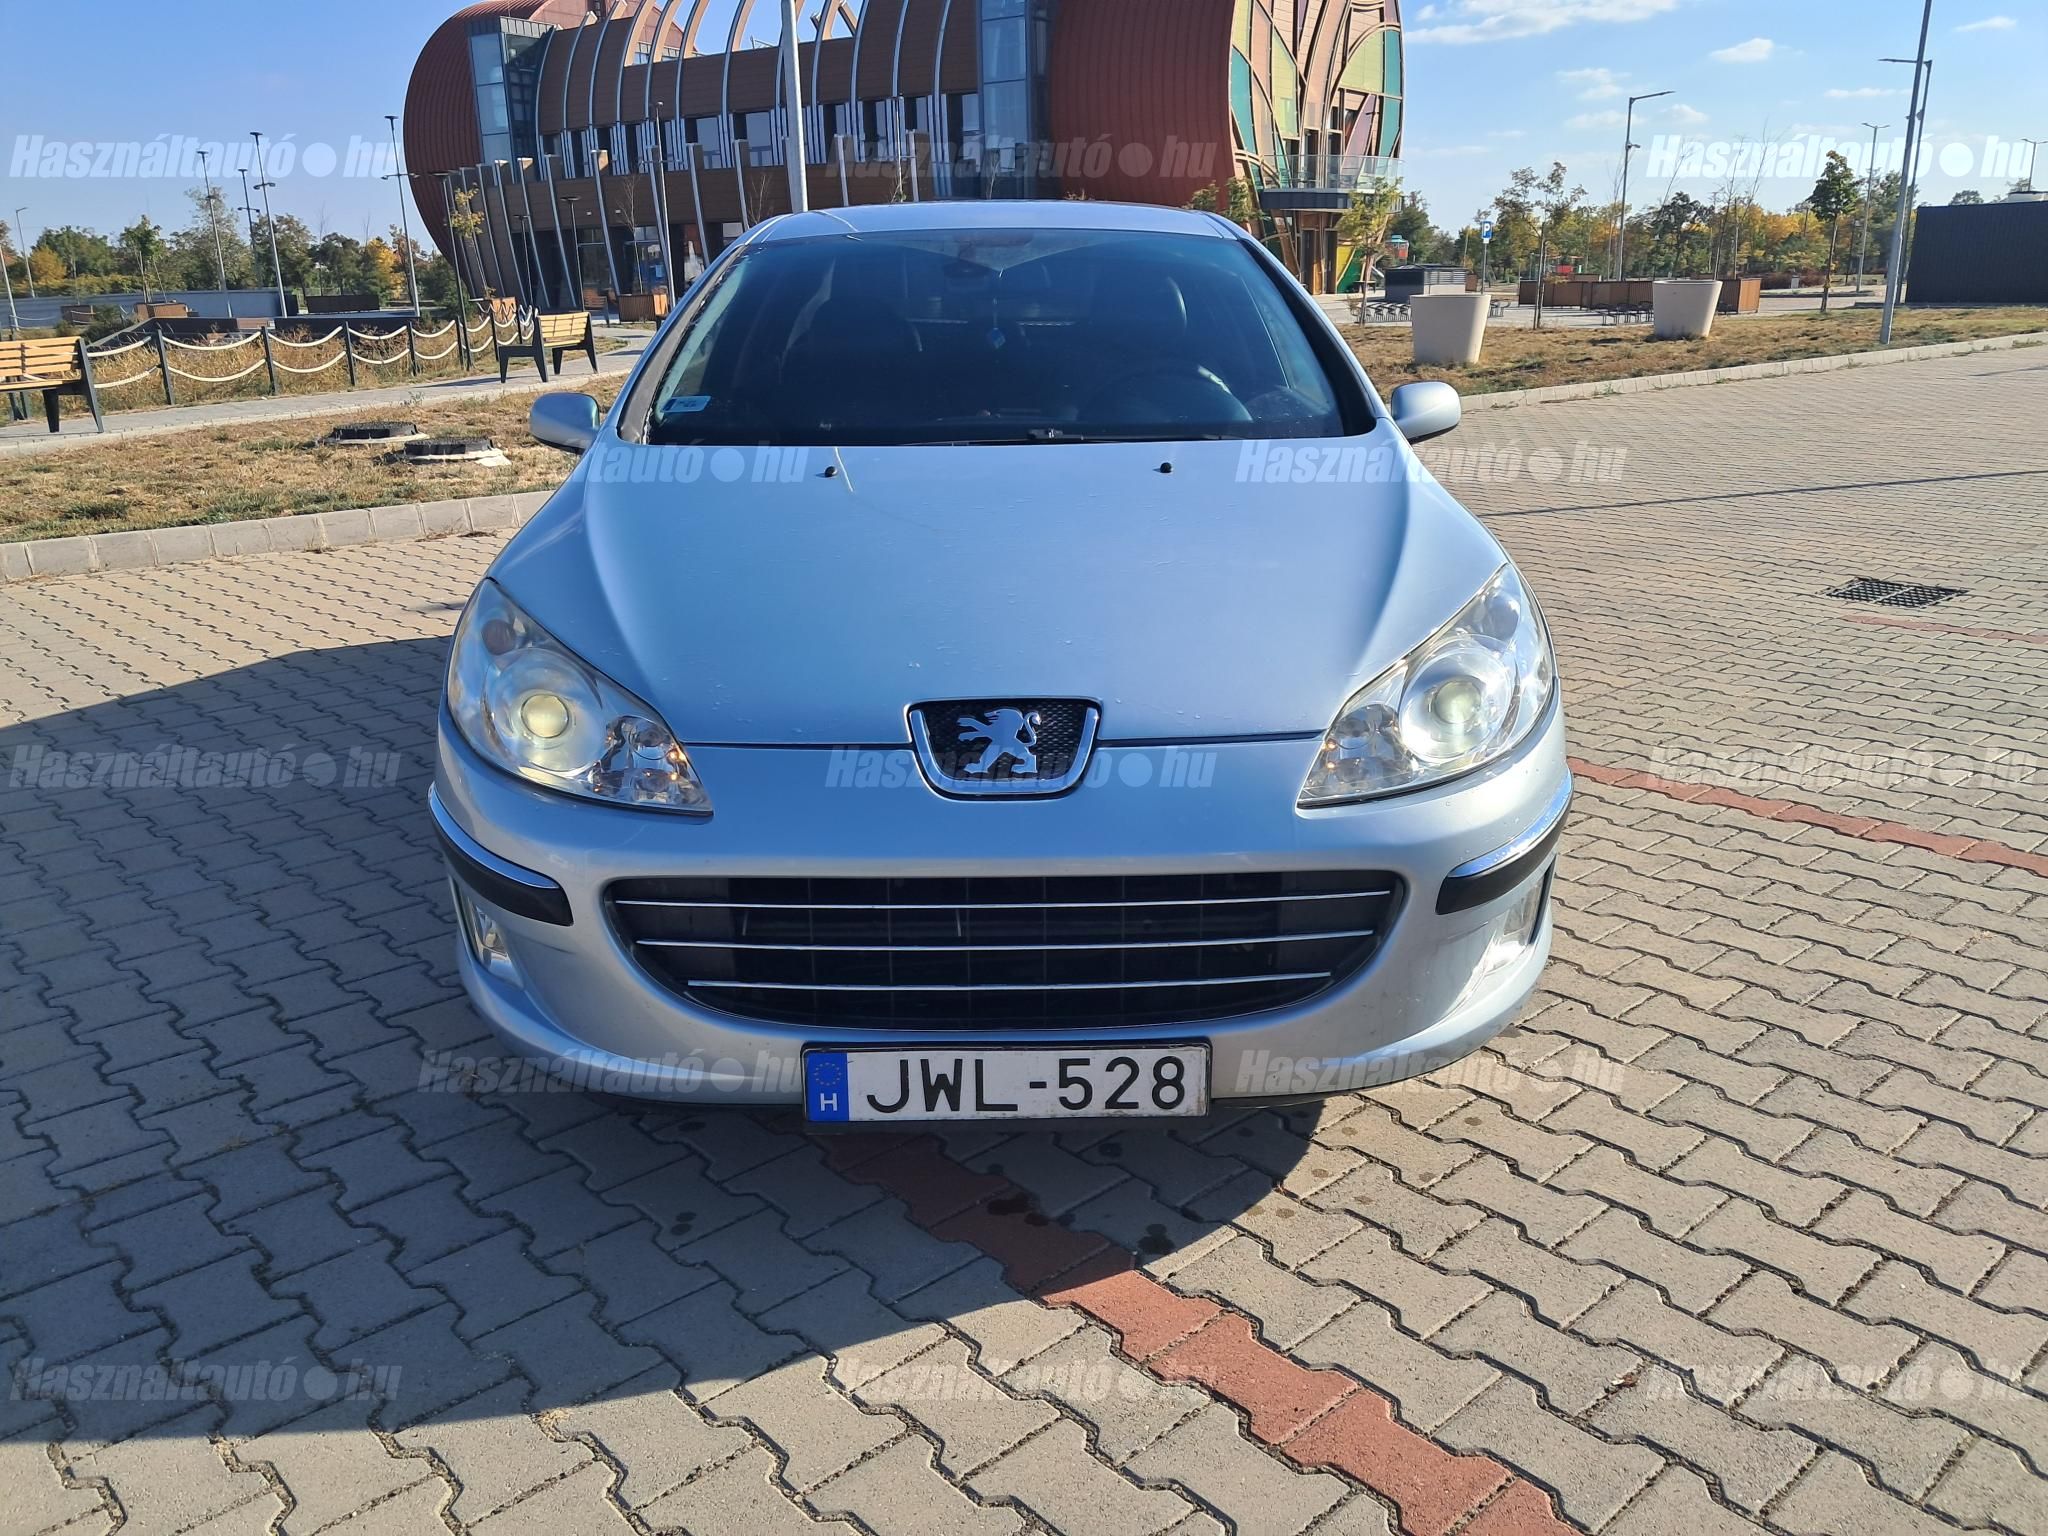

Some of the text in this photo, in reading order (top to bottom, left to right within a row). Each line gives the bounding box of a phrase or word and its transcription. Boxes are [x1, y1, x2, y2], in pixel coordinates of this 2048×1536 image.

[1483, 222, 1491, 236] P
[867, 1056, 1185, 1113] JWL-528
[820, 1093, 838, 1111] H
